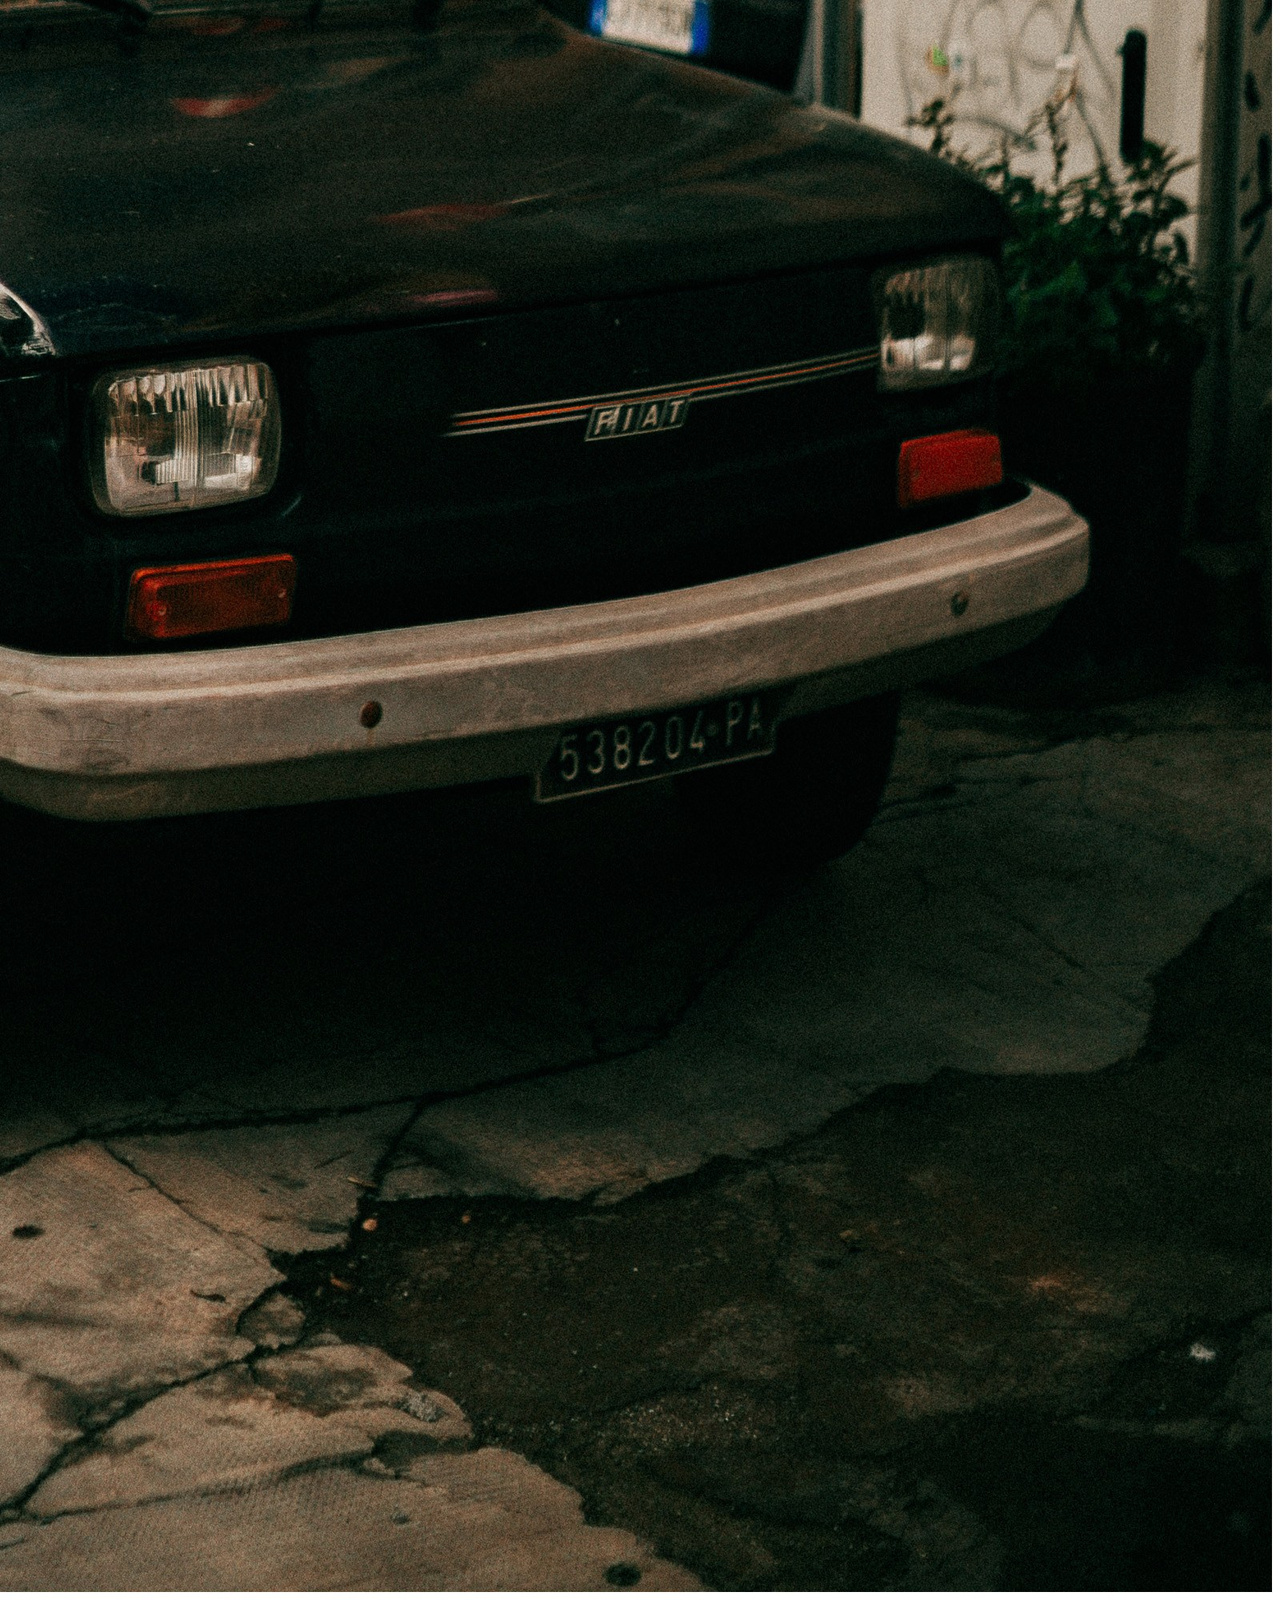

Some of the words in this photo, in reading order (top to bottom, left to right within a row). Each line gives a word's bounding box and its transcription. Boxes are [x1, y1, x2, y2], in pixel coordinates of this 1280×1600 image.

[593, 399, 686, 436] FIAT
[560, 710, 705, 781] 538204
[726, 698, 762, 747] PA
